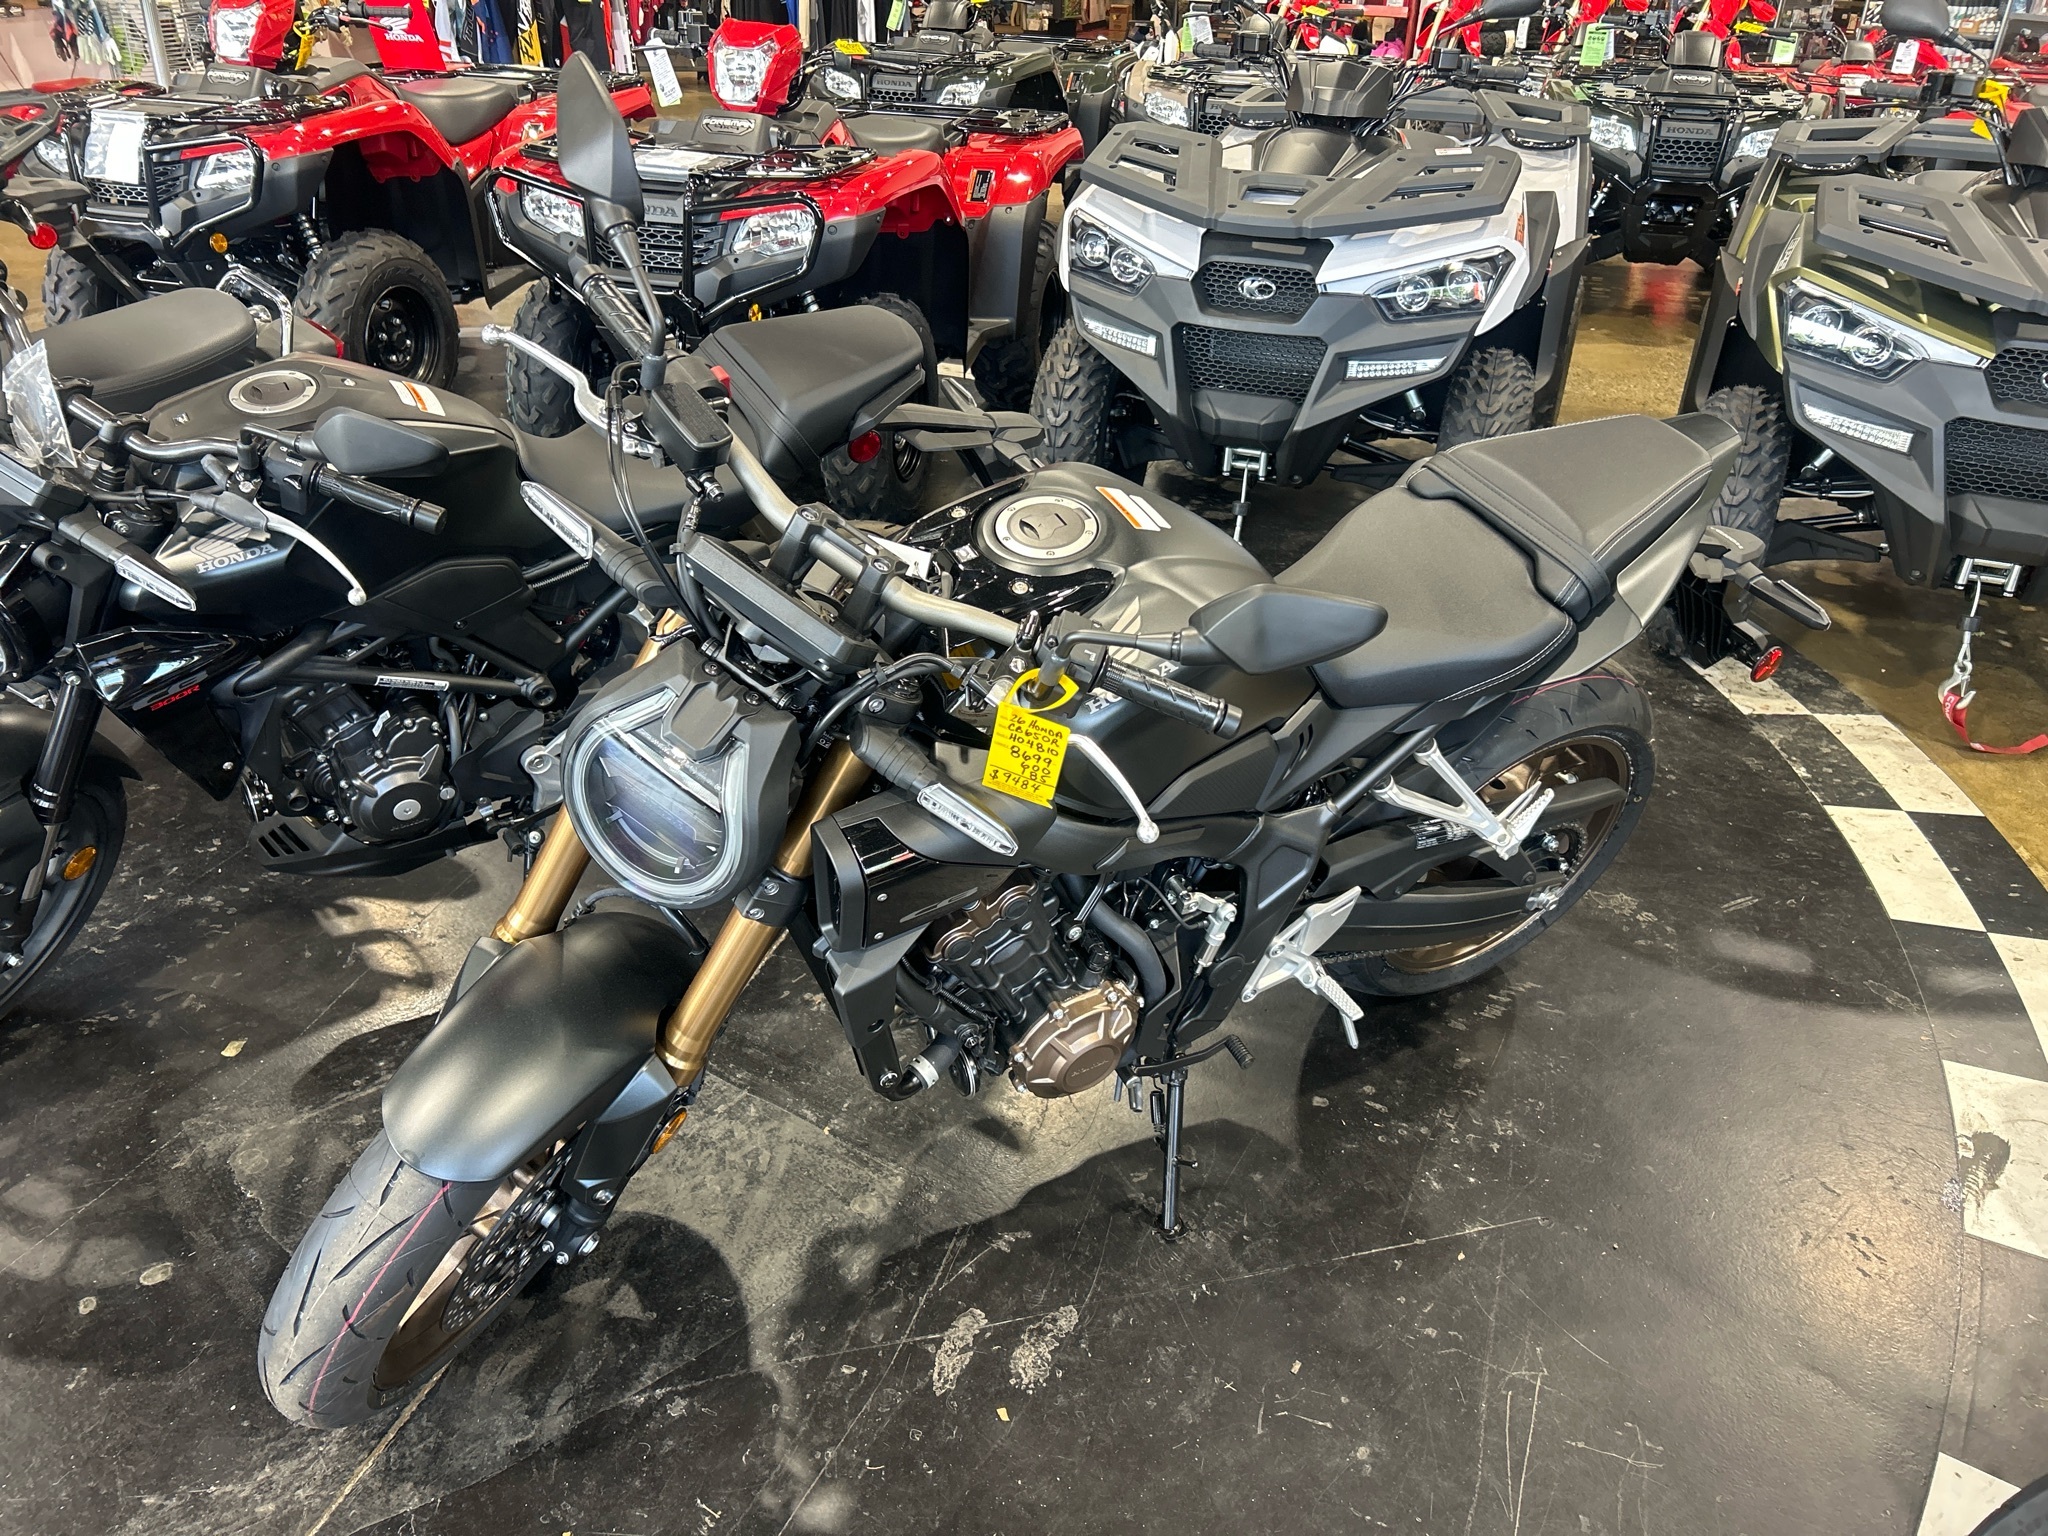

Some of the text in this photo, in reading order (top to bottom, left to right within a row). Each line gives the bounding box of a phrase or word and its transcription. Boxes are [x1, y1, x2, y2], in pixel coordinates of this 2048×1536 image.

[383, 32, 425, 43] HONDA
[876, 79, 913, 88] HONDA
[702, 118, 756, 130] FOREMAN
[1666, 126, 1714, 136] HONDA
[644, 204, 679, 218] NDA
[195, 543, 279, 574] HONDA
[151, 684, 201, 712] 300R
[1009, 714, 1026, 725] 26
[1007, 722, 1060, 748] CB650R
[1010, 745, 1053, 768] 8699
